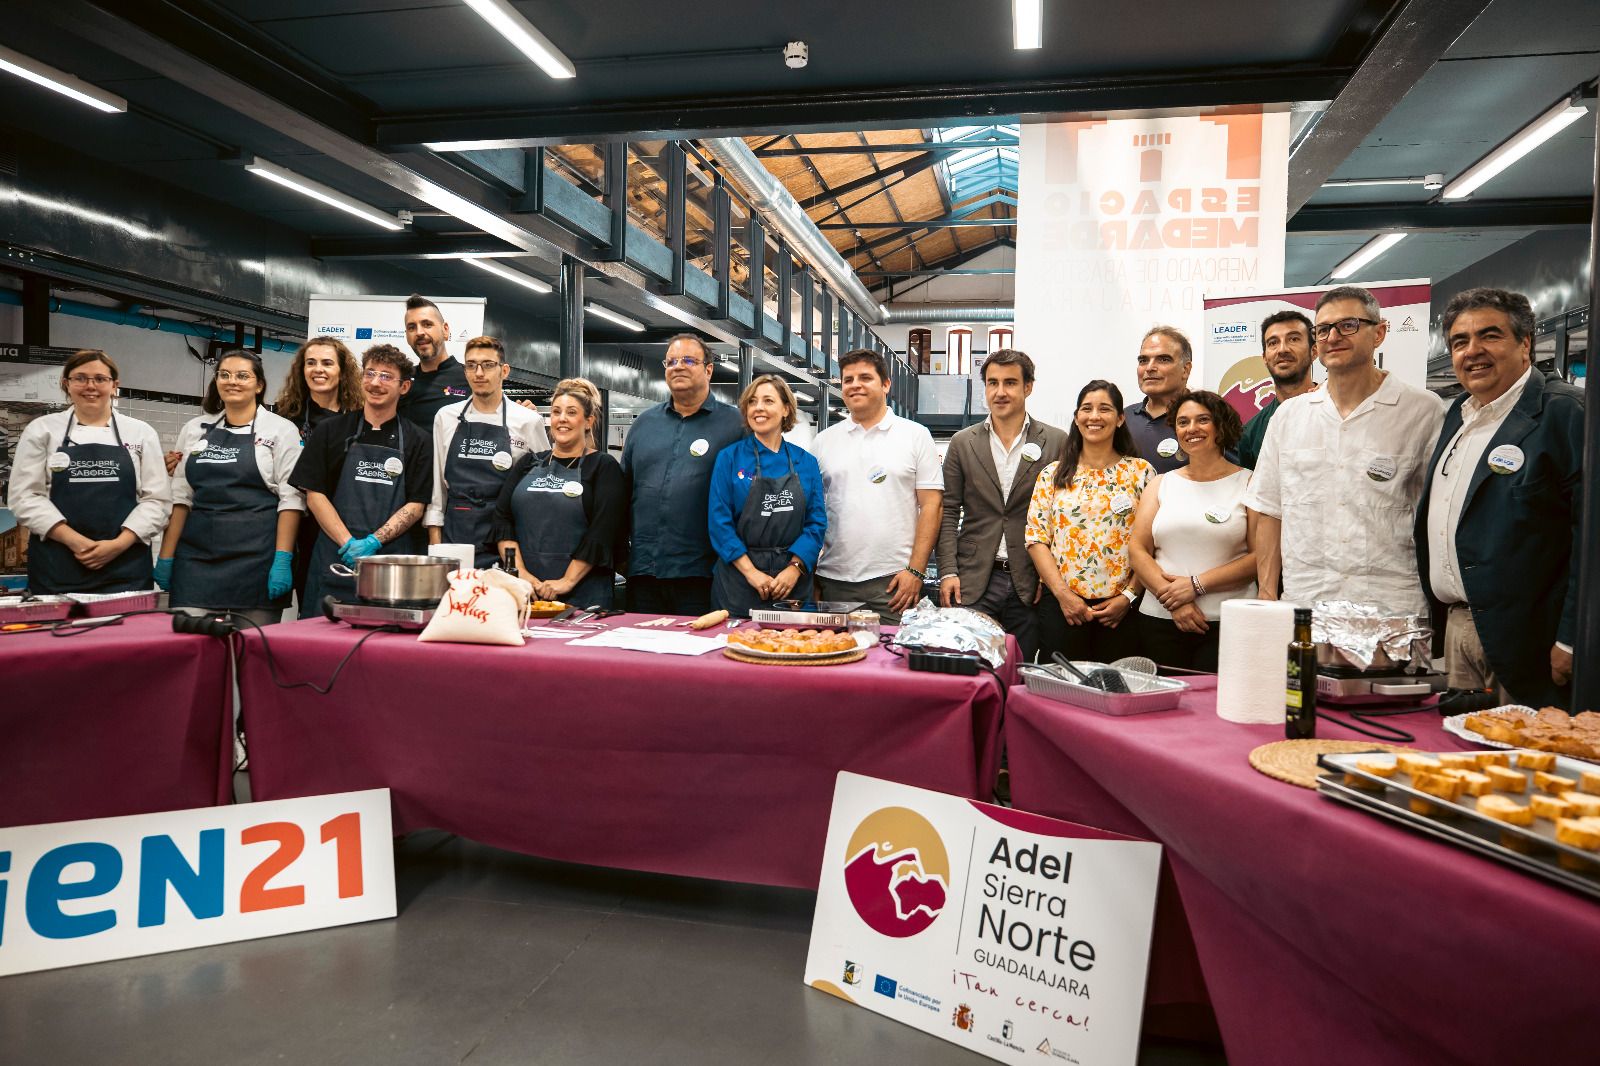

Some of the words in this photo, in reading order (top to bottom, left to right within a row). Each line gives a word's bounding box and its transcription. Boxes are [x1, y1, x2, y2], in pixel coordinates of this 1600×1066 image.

[1214, 325, 1248, 334] LEADER
[70, 460, 115, 468] DESCUBRE
[460, 446, 494, 455] SBOREA
[70, 469, 118, 477] SABOREA
[988, 836, 1072, 884] Adel
[983, 873, 1066, 919] Sierra
[978, 903, 1096, 972] Norte
[973, 948, 1091, 1000] GUADALAJARA
[1015, 996, 1090, 1032] cerca!
